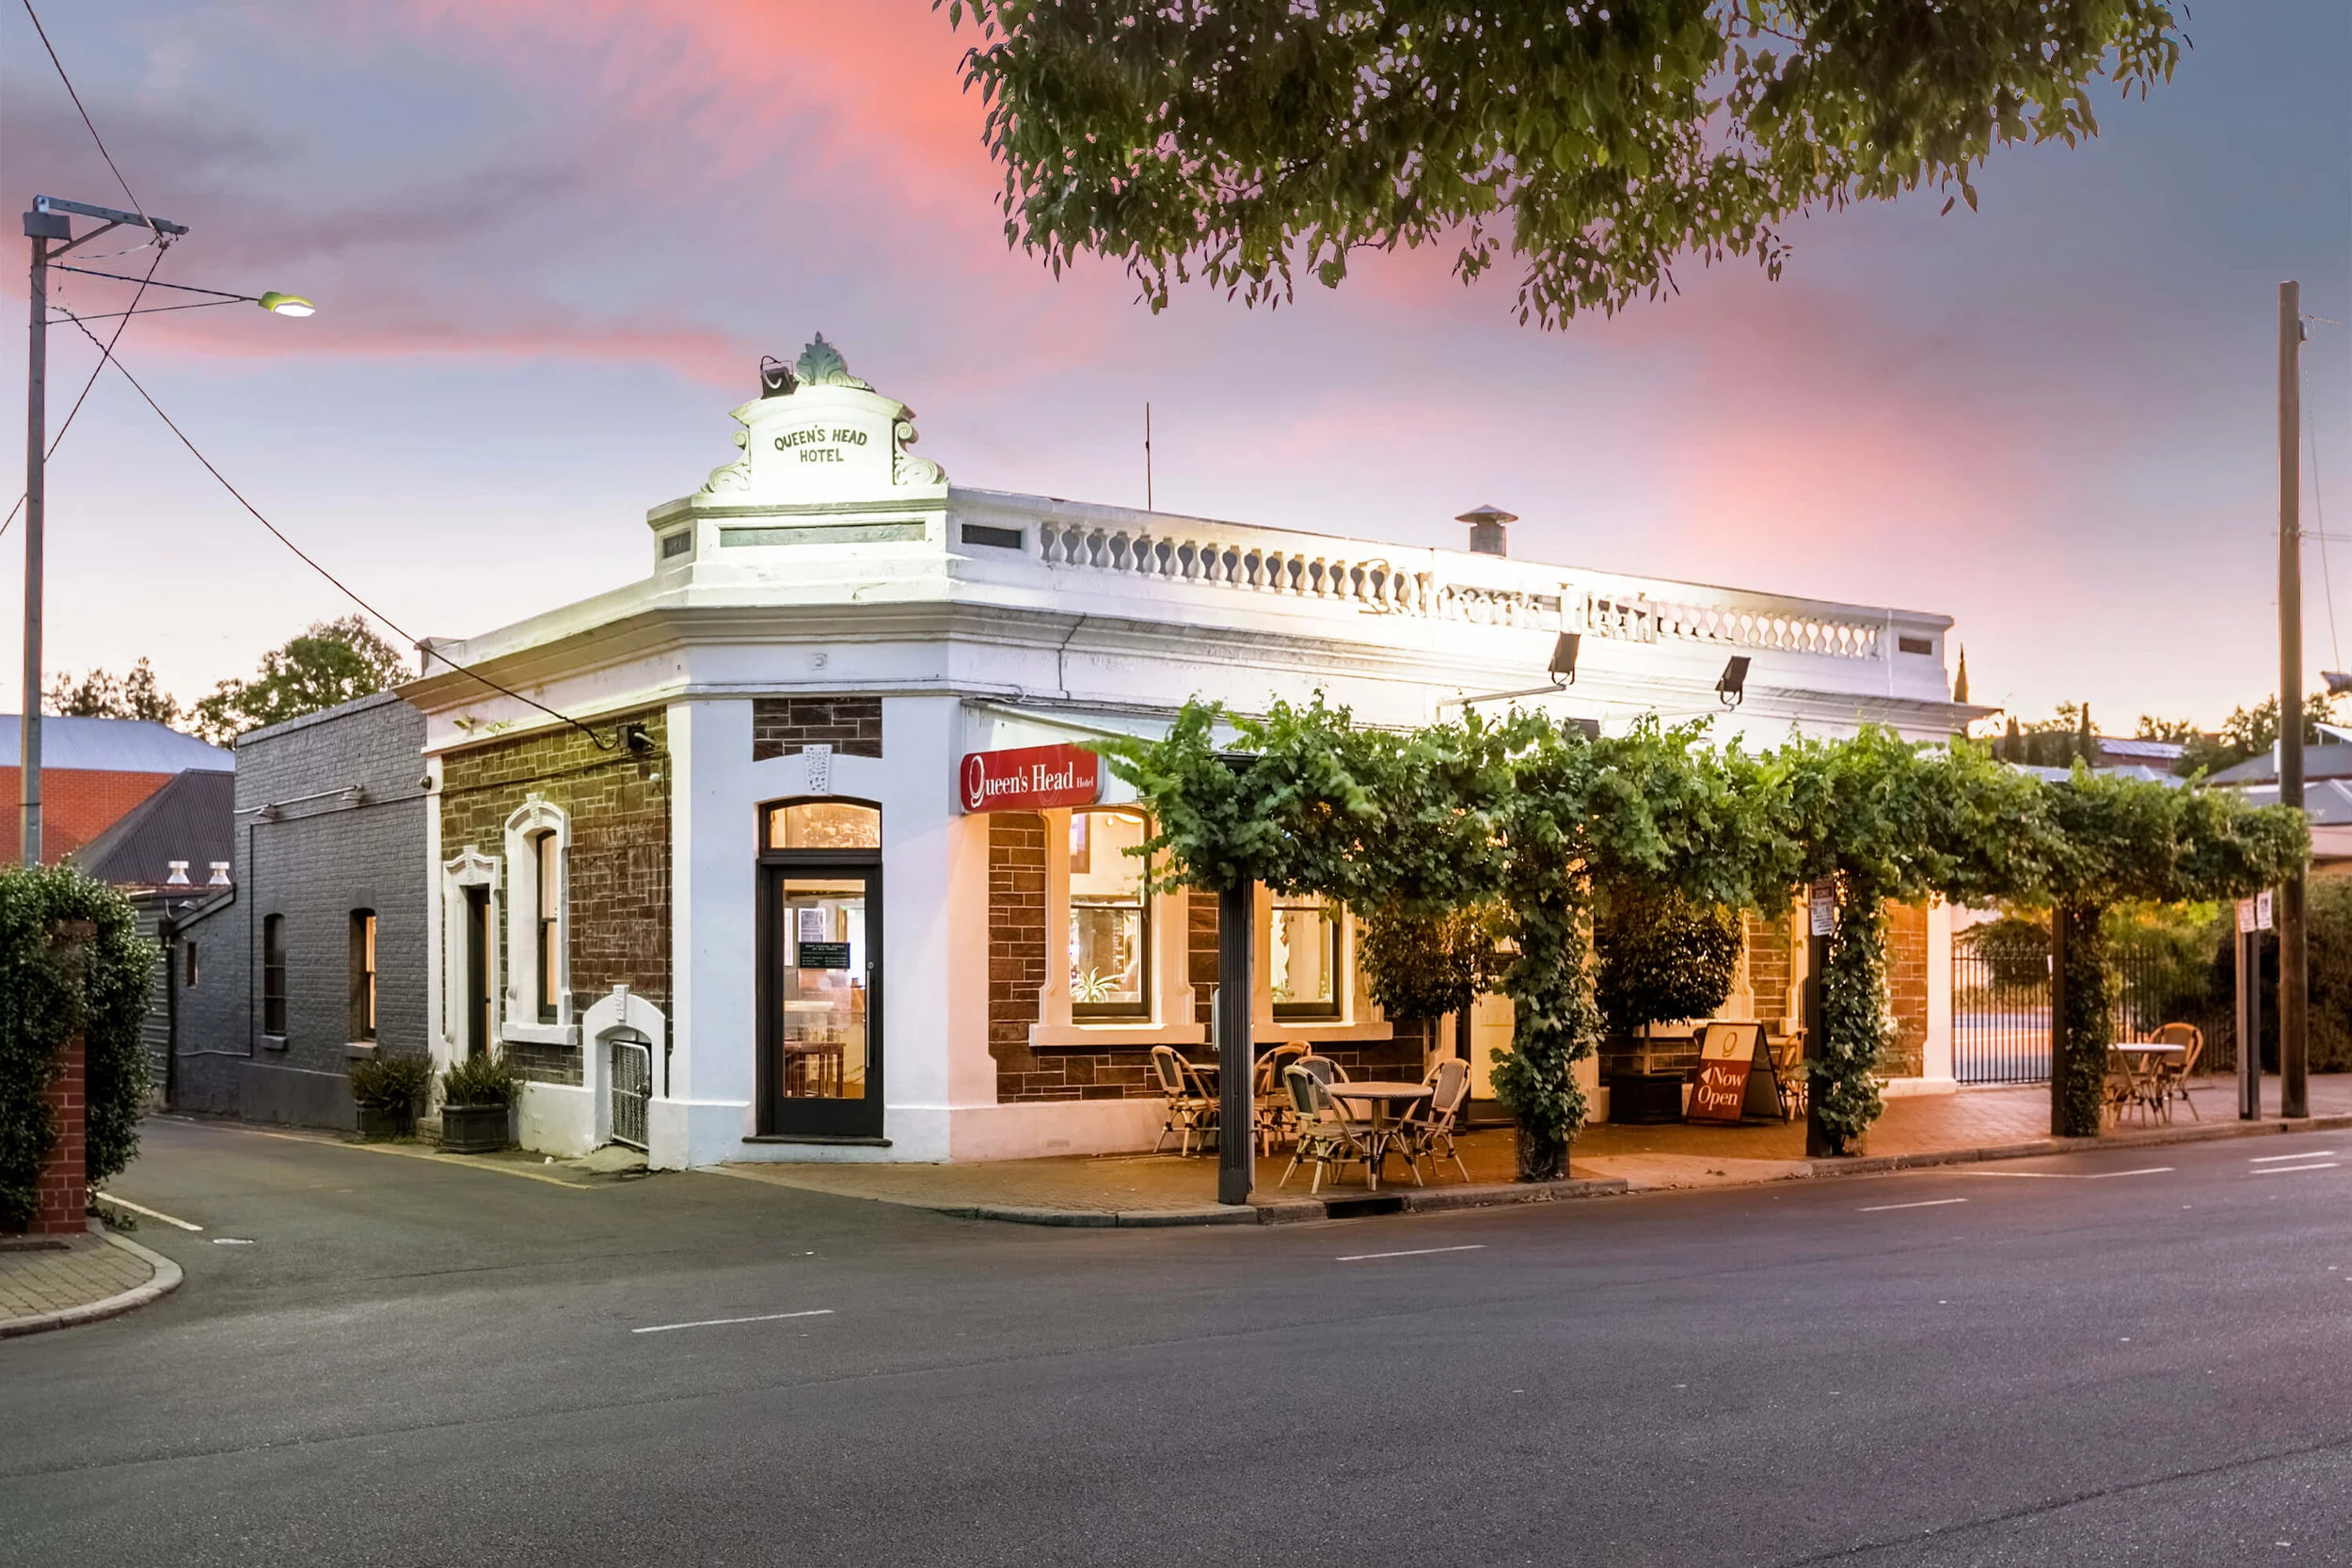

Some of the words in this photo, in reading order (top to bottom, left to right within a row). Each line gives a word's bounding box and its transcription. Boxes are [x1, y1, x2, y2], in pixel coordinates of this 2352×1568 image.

[774, 425, 825, 451] QUEEN'S
[832, 429, 867, 446] HEAD
[800, 449, 844, 462] HOTEL
[969, 755, 1027, 808] Queen's
[1031, 762, 1073, 792] Head
[1076, 776, 1094, 788] Hotel
[1711, 1067, 1745, 1087] Now
[1697, 1085, 1739, 1111] Open
